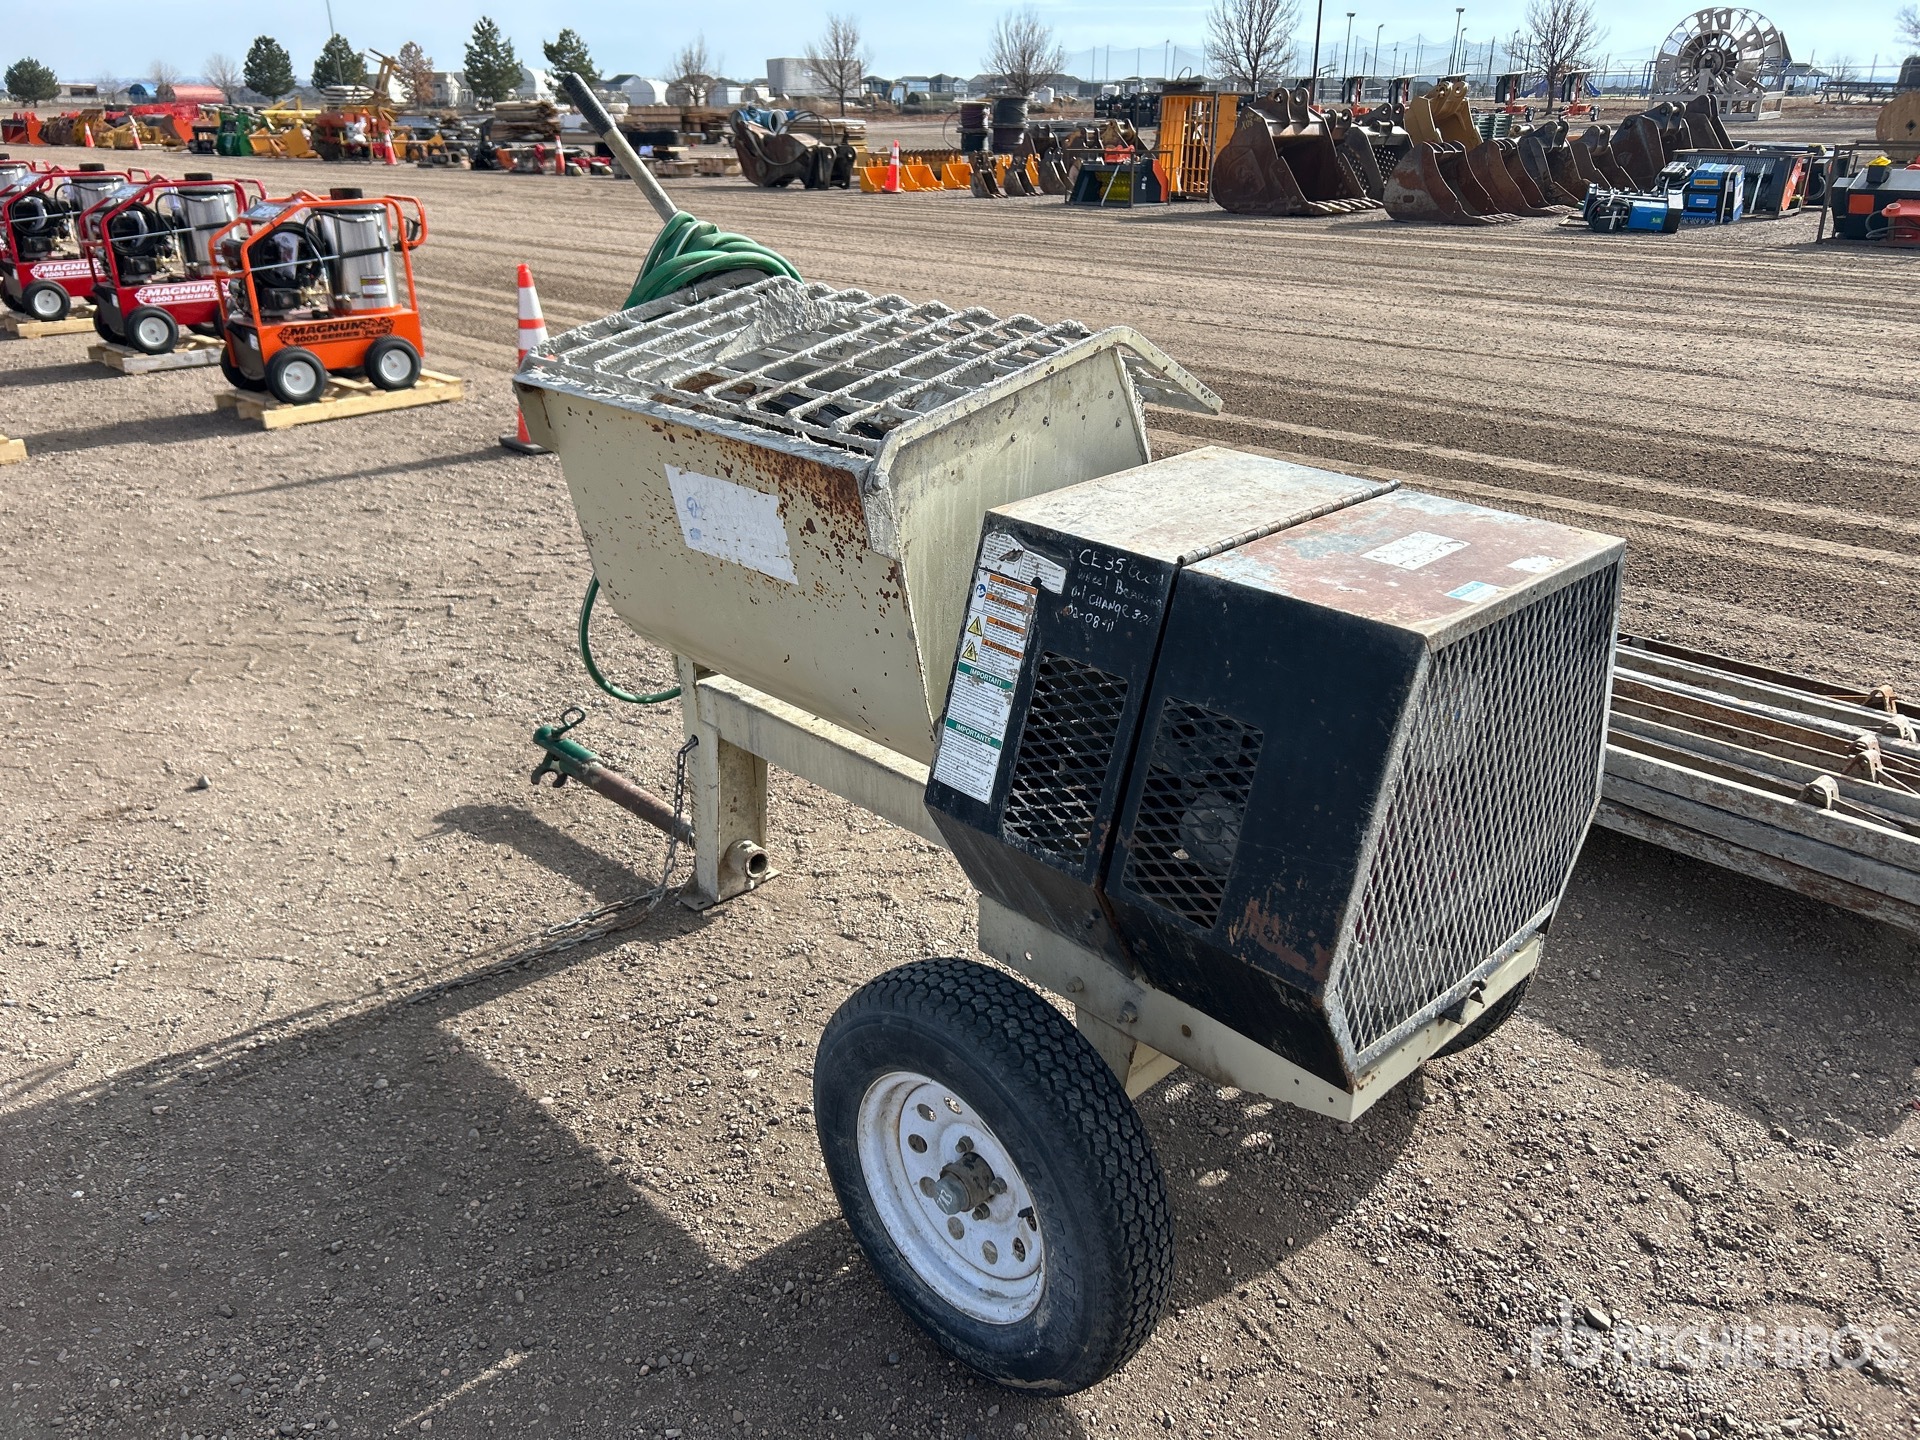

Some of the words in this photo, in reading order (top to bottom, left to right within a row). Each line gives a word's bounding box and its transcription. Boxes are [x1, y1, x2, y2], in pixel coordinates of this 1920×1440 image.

[146, 284, 214, 297] MAGNUM
[174, 291, 211, 300] SERIES
[290, 321, 365, 336] MAGNUM
[293, 334, 319, 343] 4000
[321, 331, 360, 340] SERIES
